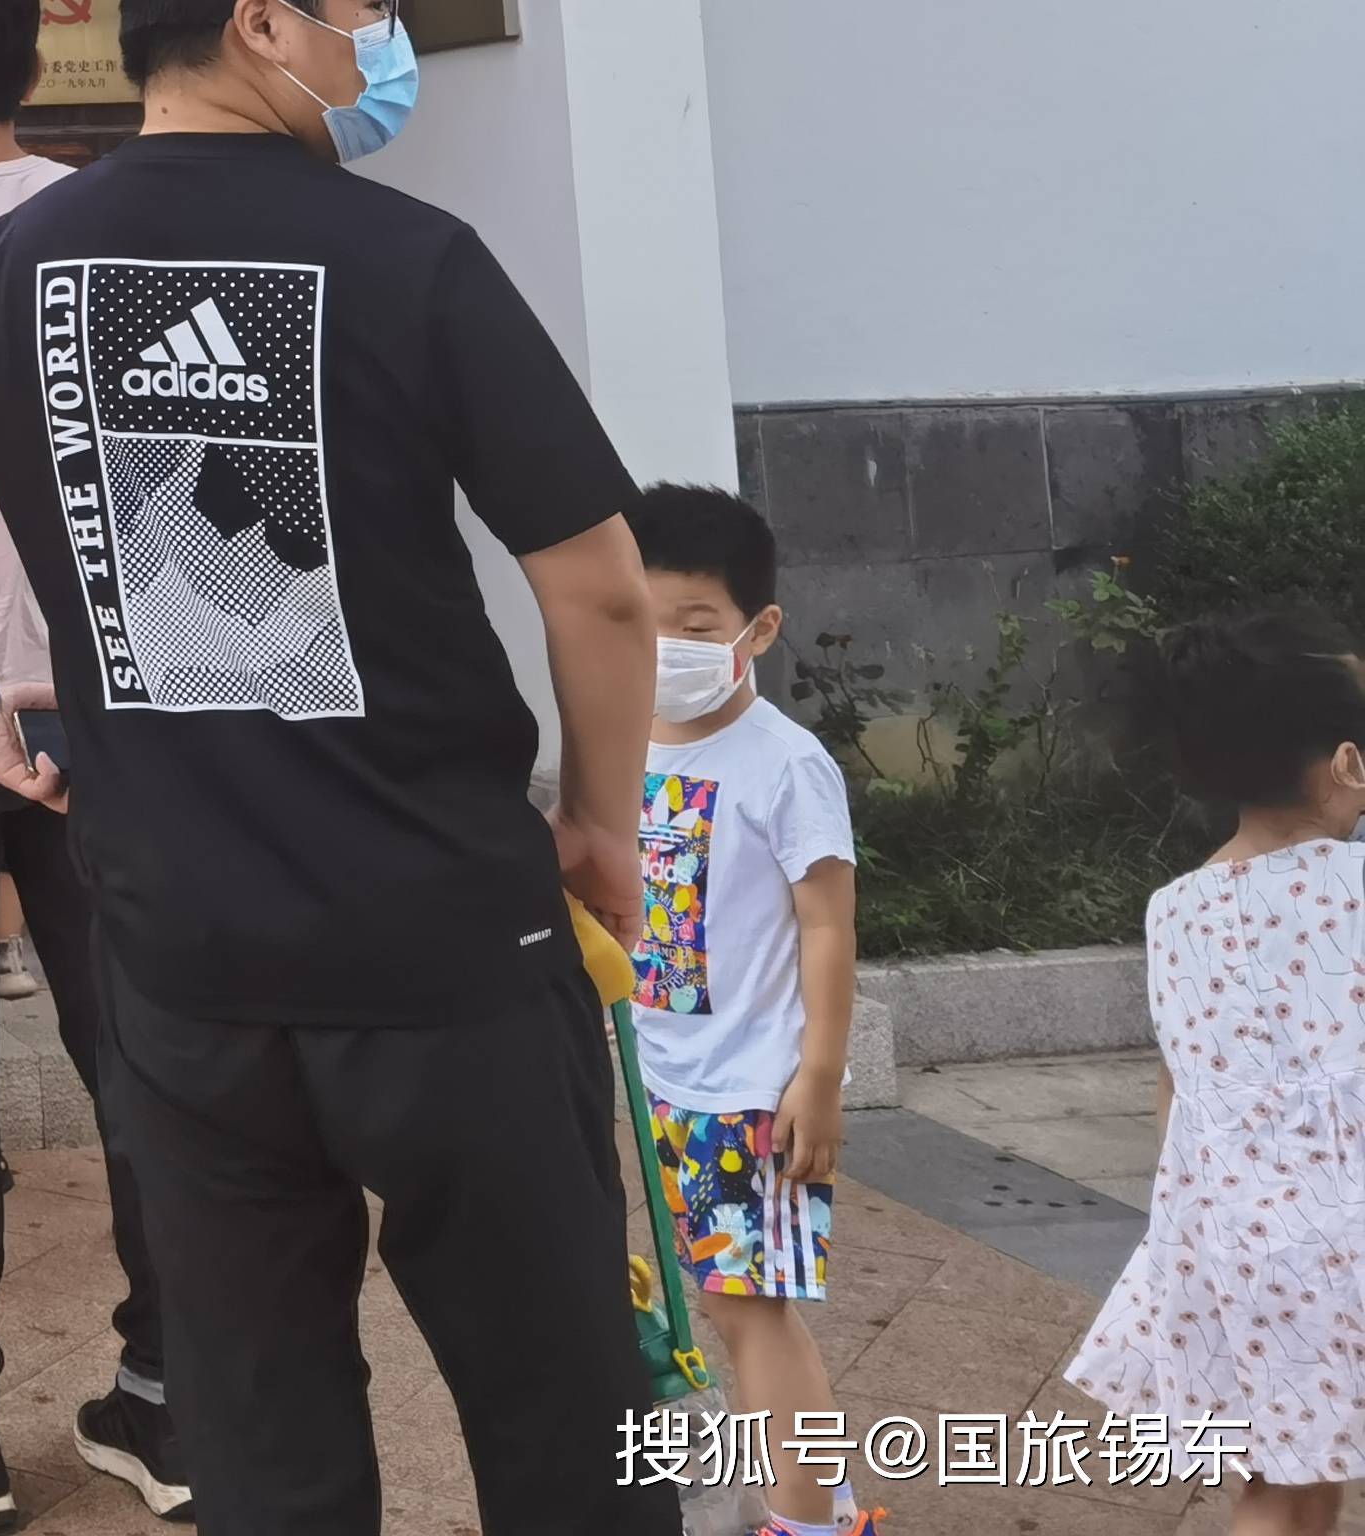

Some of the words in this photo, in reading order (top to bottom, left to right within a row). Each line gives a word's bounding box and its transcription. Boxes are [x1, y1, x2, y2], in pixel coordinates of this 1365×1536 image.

[44, 275, 93, 461] WORLD
[121, 361, 270, 403] adidas
[65, 482, 109, 582] THE
[97, 604, 144, 692] SEE
